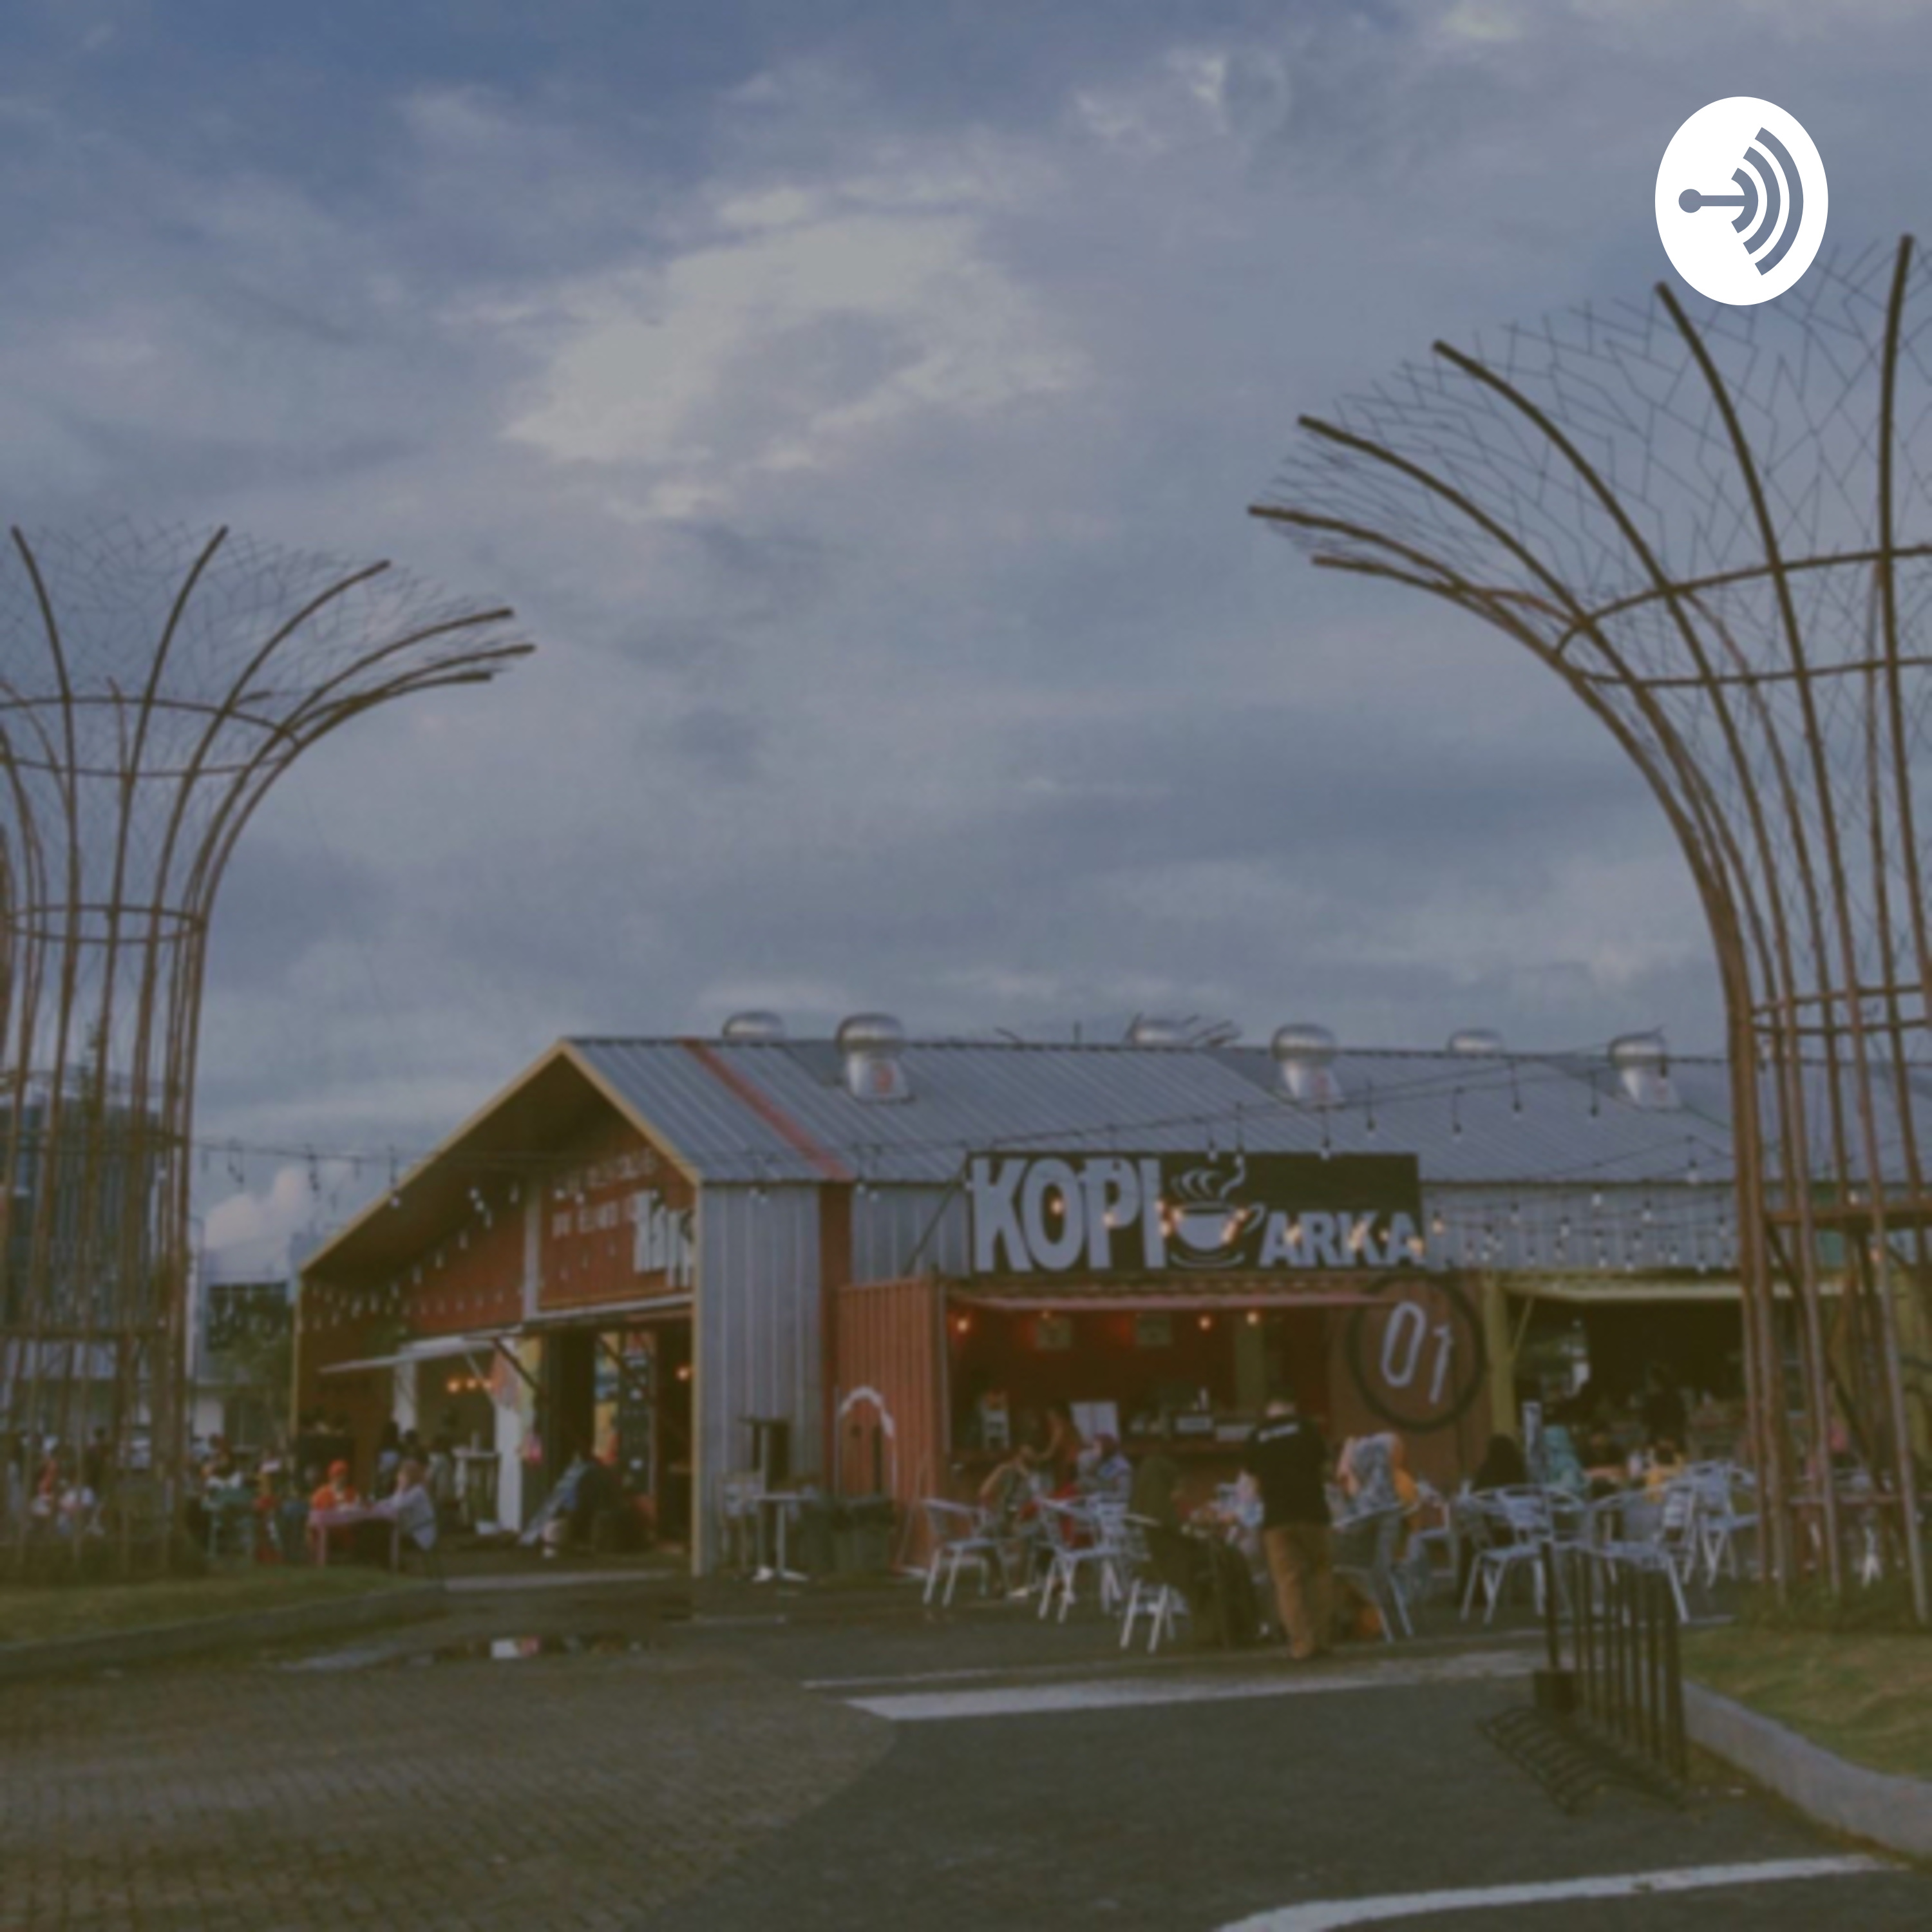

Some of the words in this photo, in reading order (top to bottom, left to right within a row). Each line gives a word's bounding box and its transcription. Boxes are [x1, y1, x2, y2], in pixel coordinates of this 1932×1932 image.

[972, 1158, 1166, 1273] KOPI
[1258, 1211, 1425, 1267] ARKA
[1381, 1300, 1454, 1404] 01
